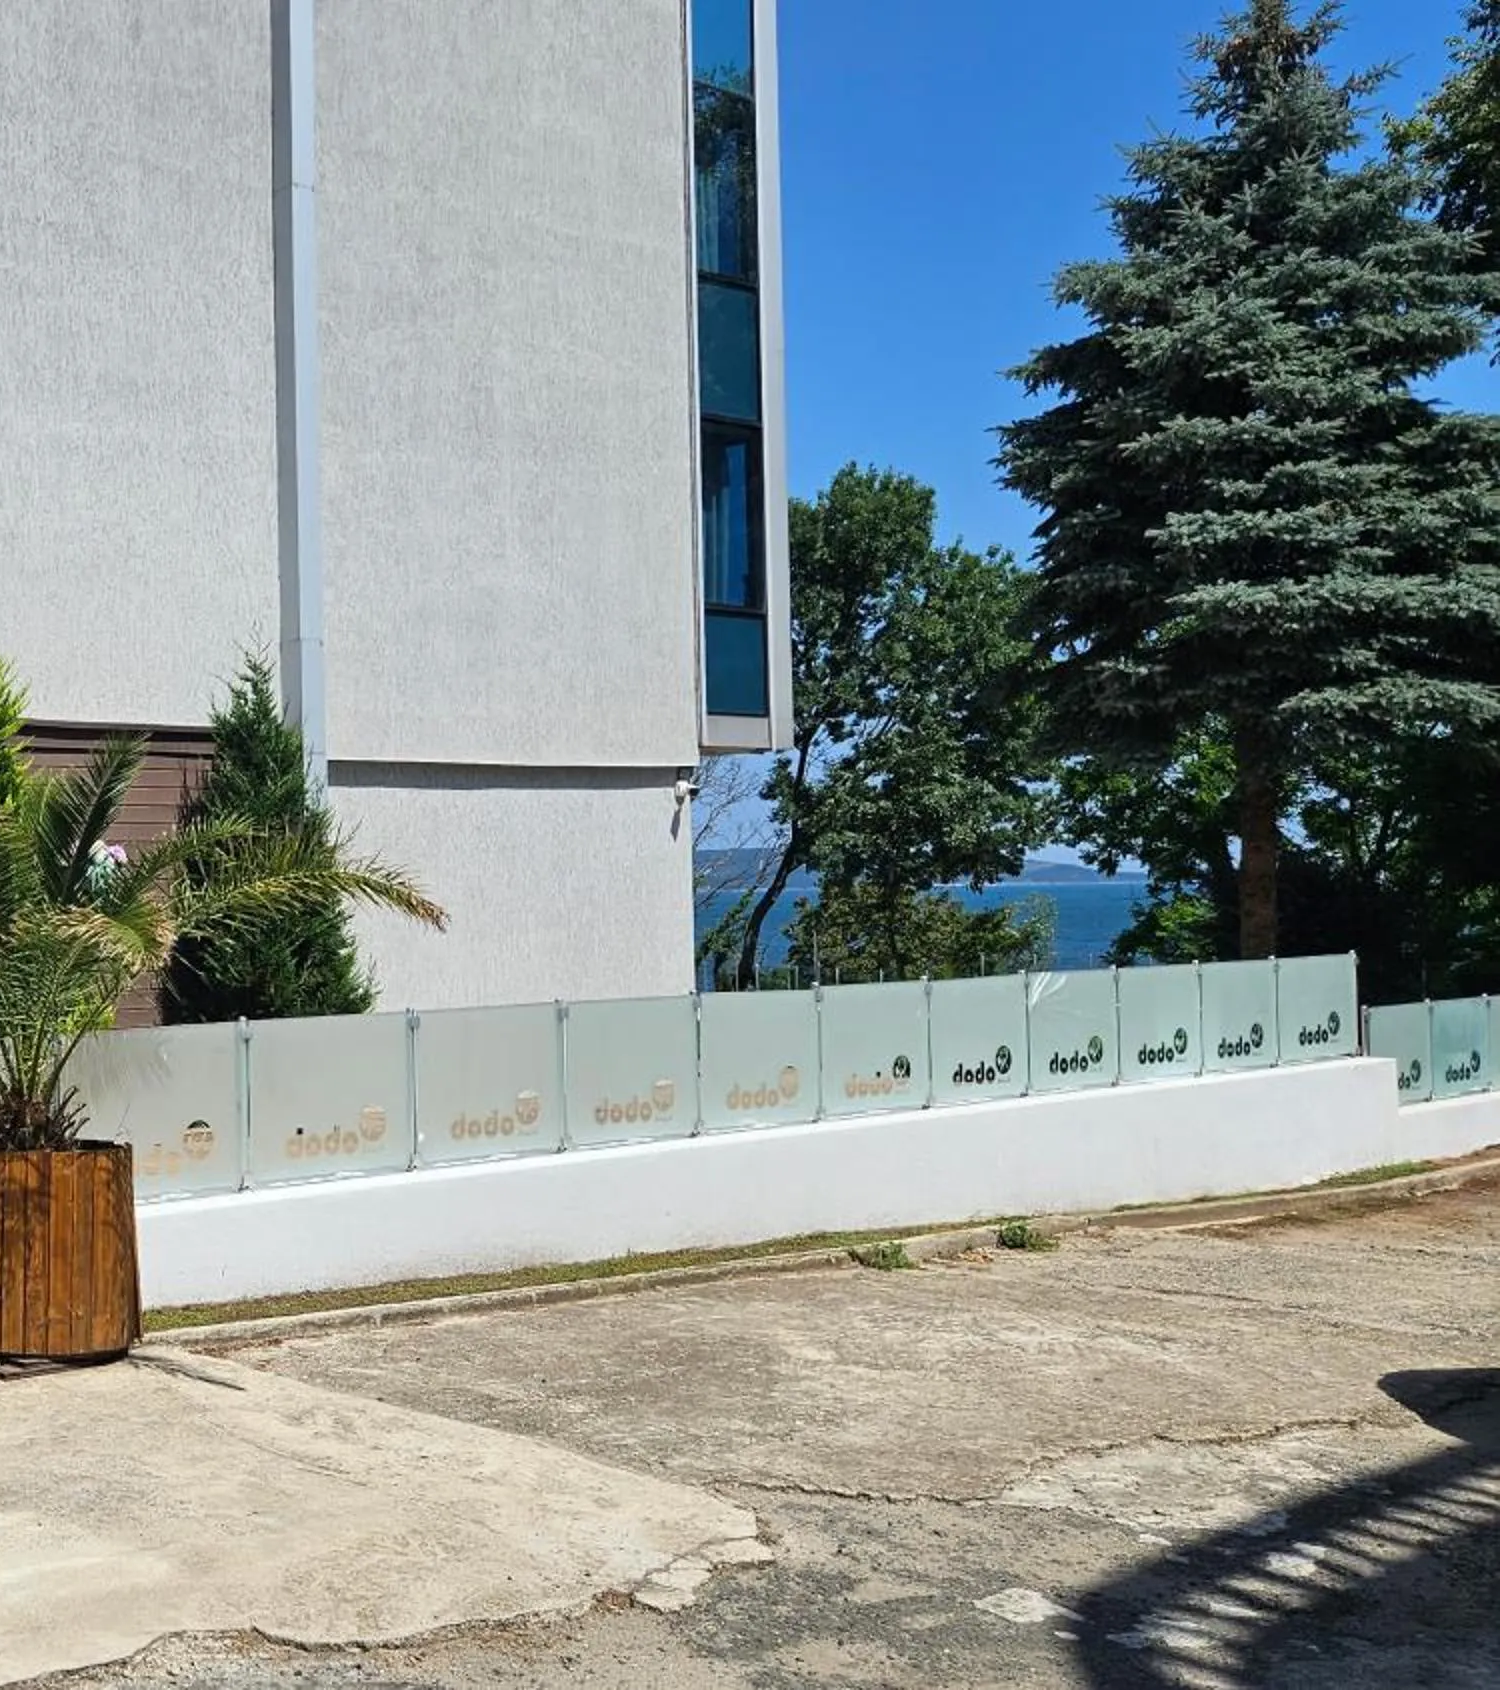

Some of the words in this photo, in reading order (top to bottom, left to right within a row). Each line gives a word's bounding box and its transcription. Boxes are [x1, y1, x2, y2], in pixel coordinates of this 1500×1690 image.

[1218, 1035, 1251, 1059] dodo
[1298, 1024, 1329, 1046] dodo
[1049, 1051, 1089, 1074] dodo
[1138, 1041, 1175, 1065] dodo
[952, 1061, 996, 1084] dodo
[1445, 1062, 1471, 1083] dodo
[726, 1082, 779, 1110] dodo
[845, 1072, 893, 1098] dodo
[595, 1095, 652, 1125] dodo
[451, 1109, 515, 1140] dodo
[286, 1125, 359, 1159] dodo
